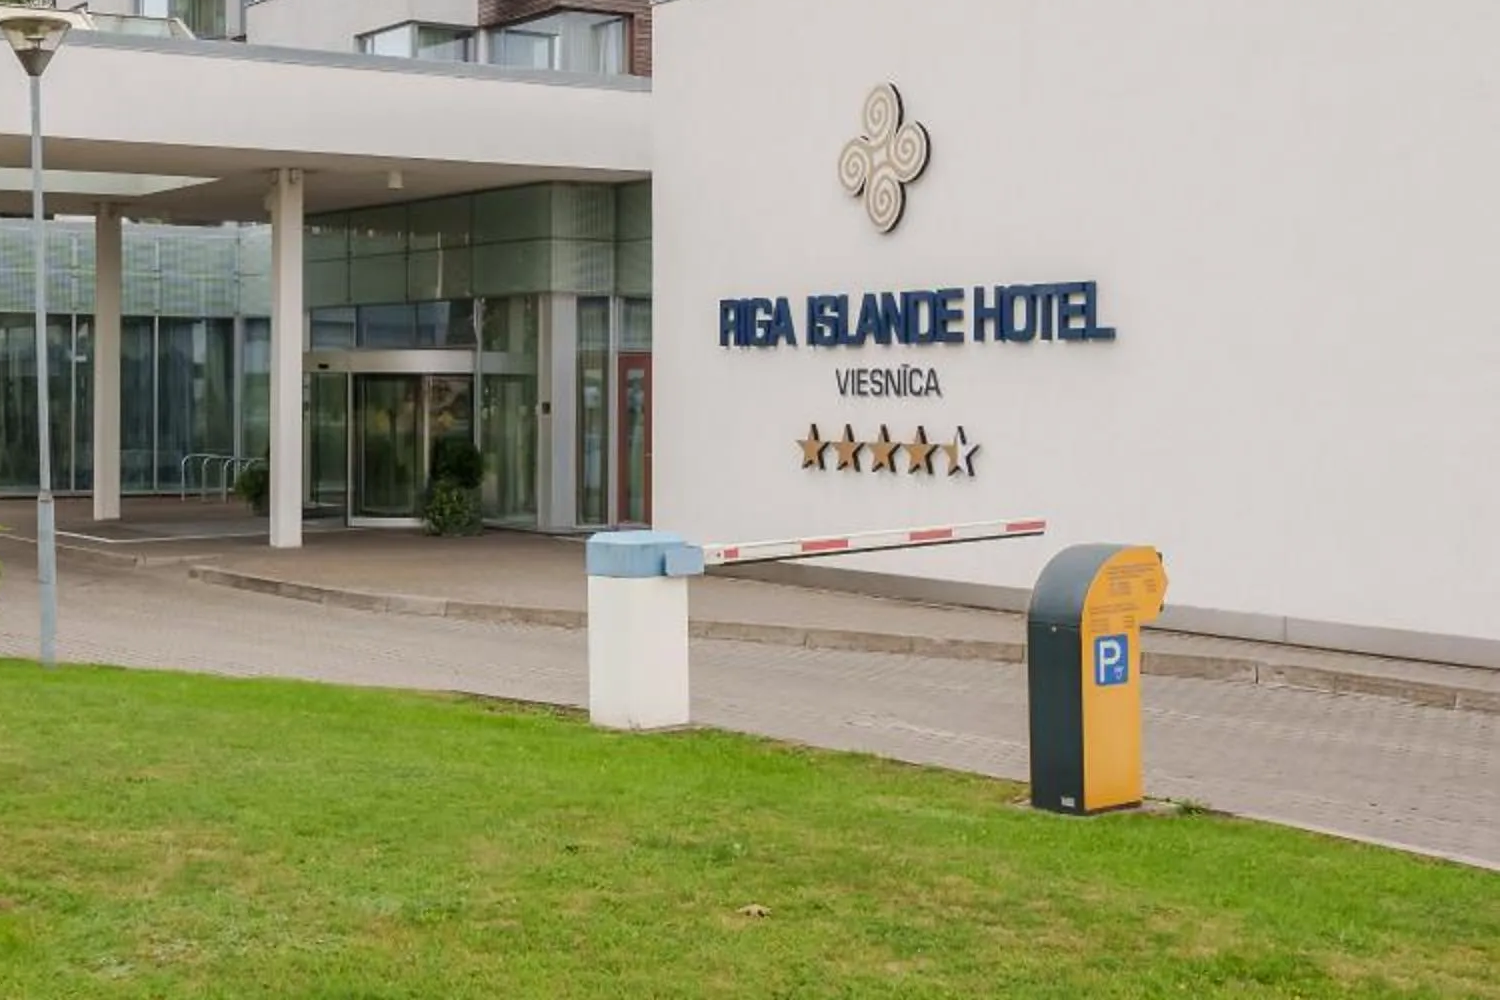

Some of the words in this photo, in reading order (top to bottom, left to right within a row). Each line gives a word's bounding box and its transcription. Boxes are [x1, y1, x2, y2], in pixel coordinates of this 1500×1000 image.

[719, 296, 797, 347] RIGA
[805, 286, 965, 347] ISLANDE
[973, 280, 1116, 344] HOTEL
[835, 363, 942, 398] VIESNĪCA
[1100, 640, 1121, 683] P
